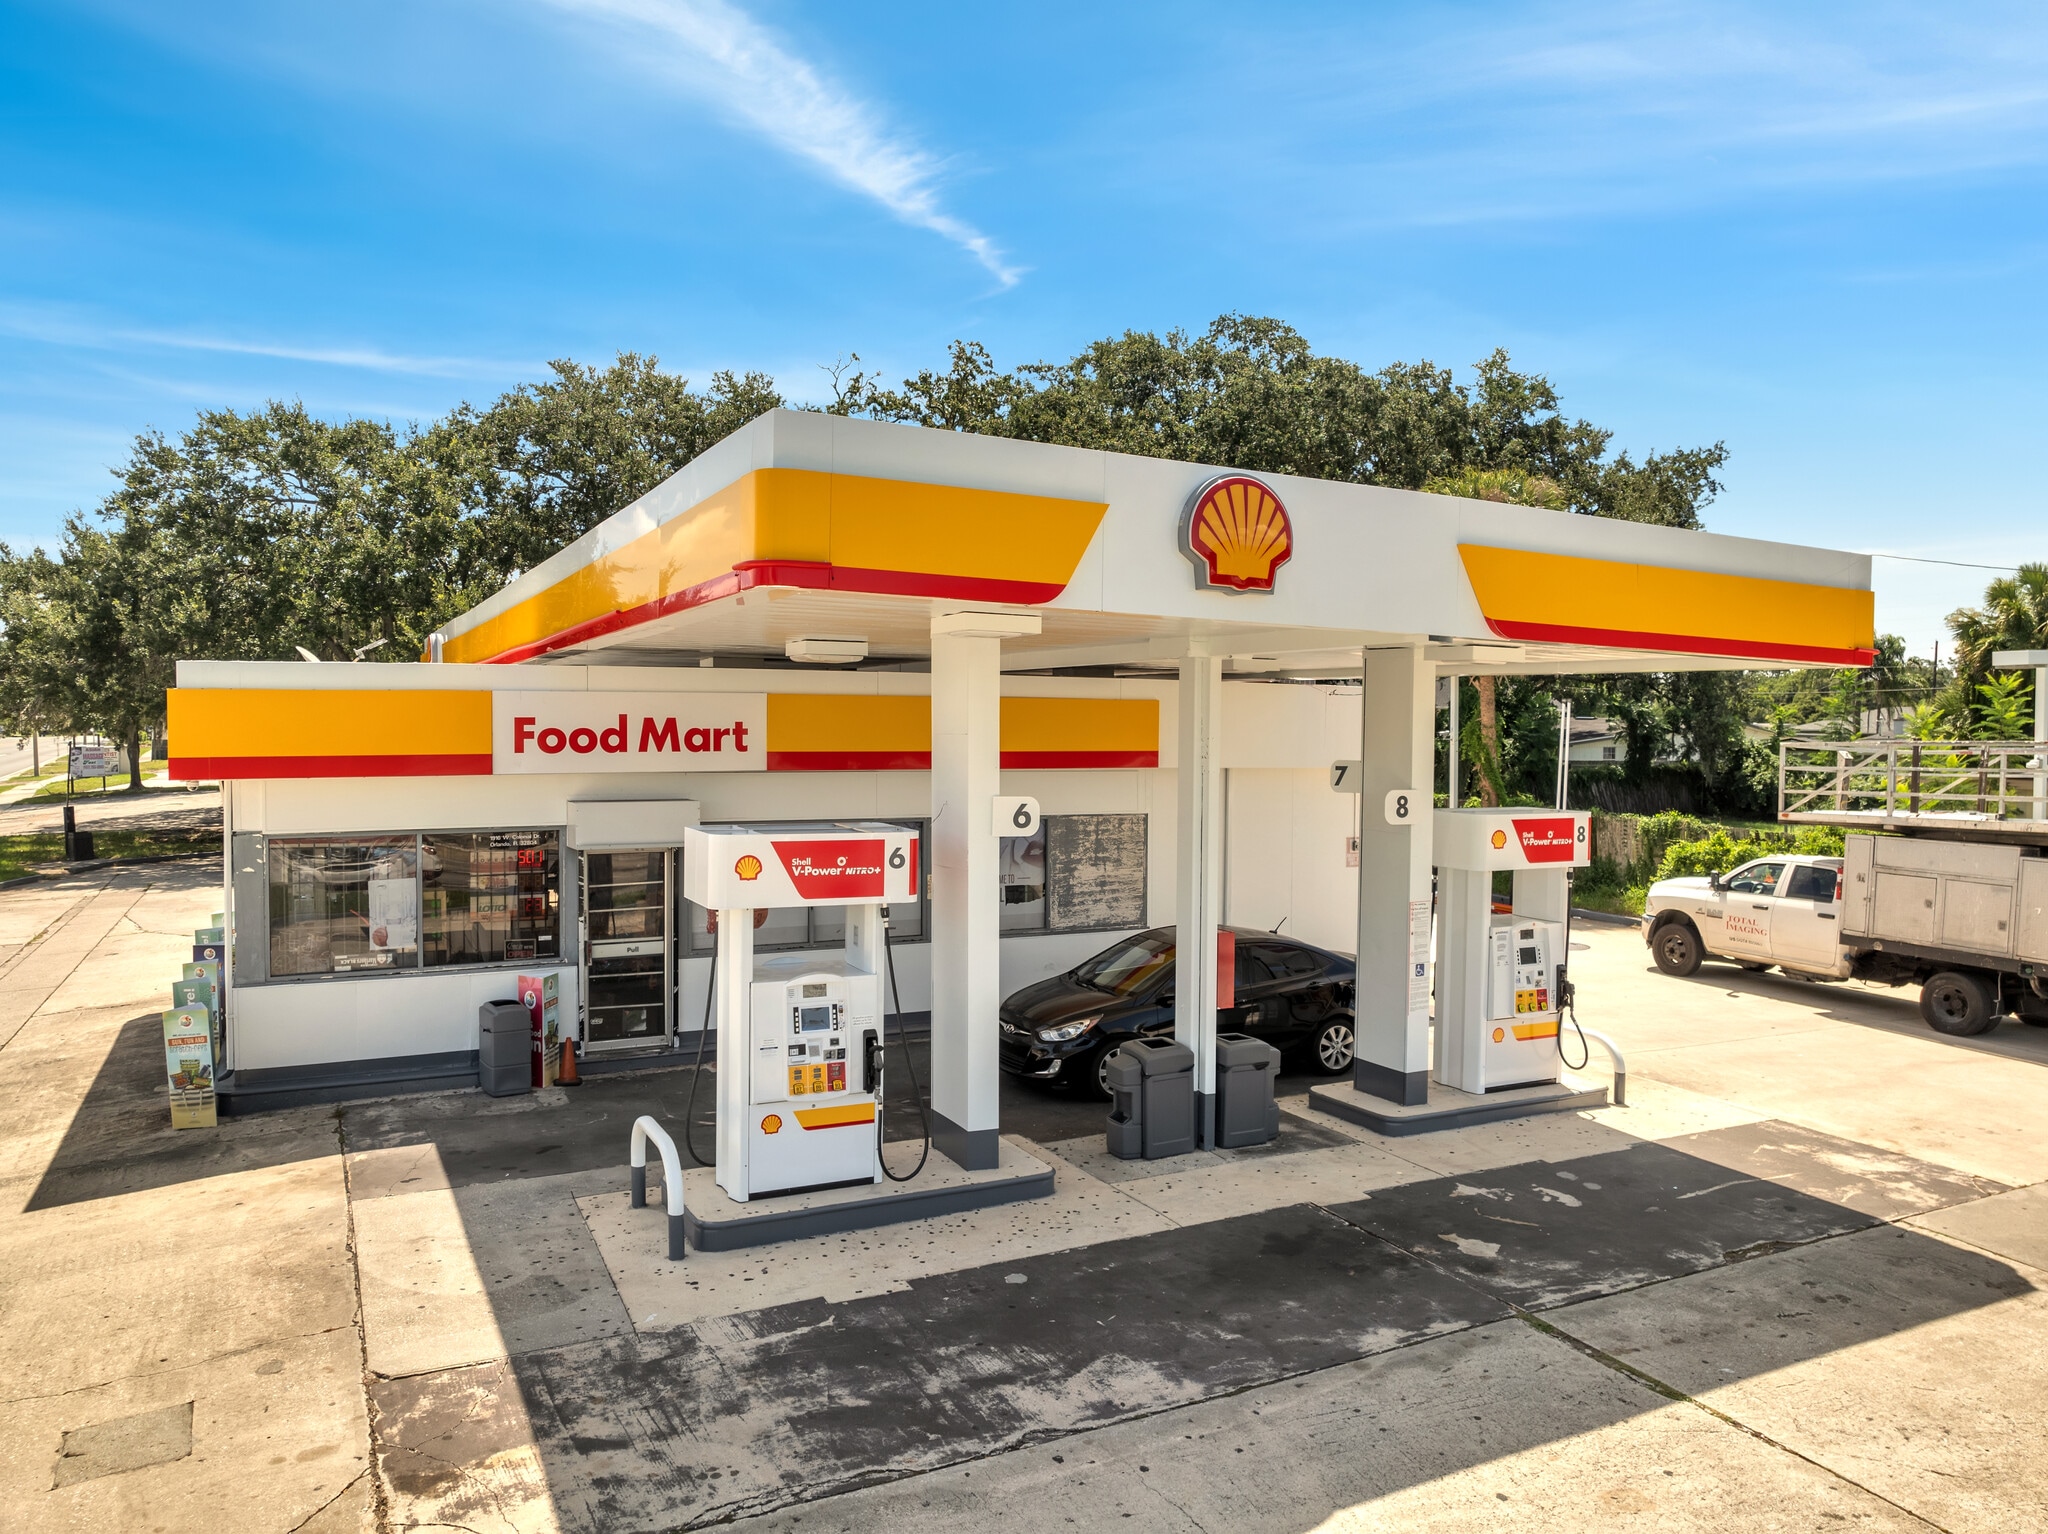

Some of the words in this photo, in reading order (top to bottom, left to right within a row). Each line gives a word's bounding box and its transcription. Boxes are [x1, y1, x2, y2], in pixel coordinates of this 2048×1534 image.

[514, 714, 628, 754] Food
[638, 717, 749, 753] Mart
[1334, 765, 1349, 786] 7
[1395, 795, 1409, 818] 8
[1012, 803, 1032, 829] 6
[1577, 825, 1586, 843] 8
[1523, 838, 1551, 846] V-Power
[791, 857, 811, 866] Shell
[888, 847, 906, 869] 6
[792, 866, 842, 876] V-Power
[1008, 874, 1015, 884] TO
[1727, 915, 1758, 926] TOTAL
[1726, 921, 1768, 936] IMAGING
[507, 950, 533, 958] OPEN
